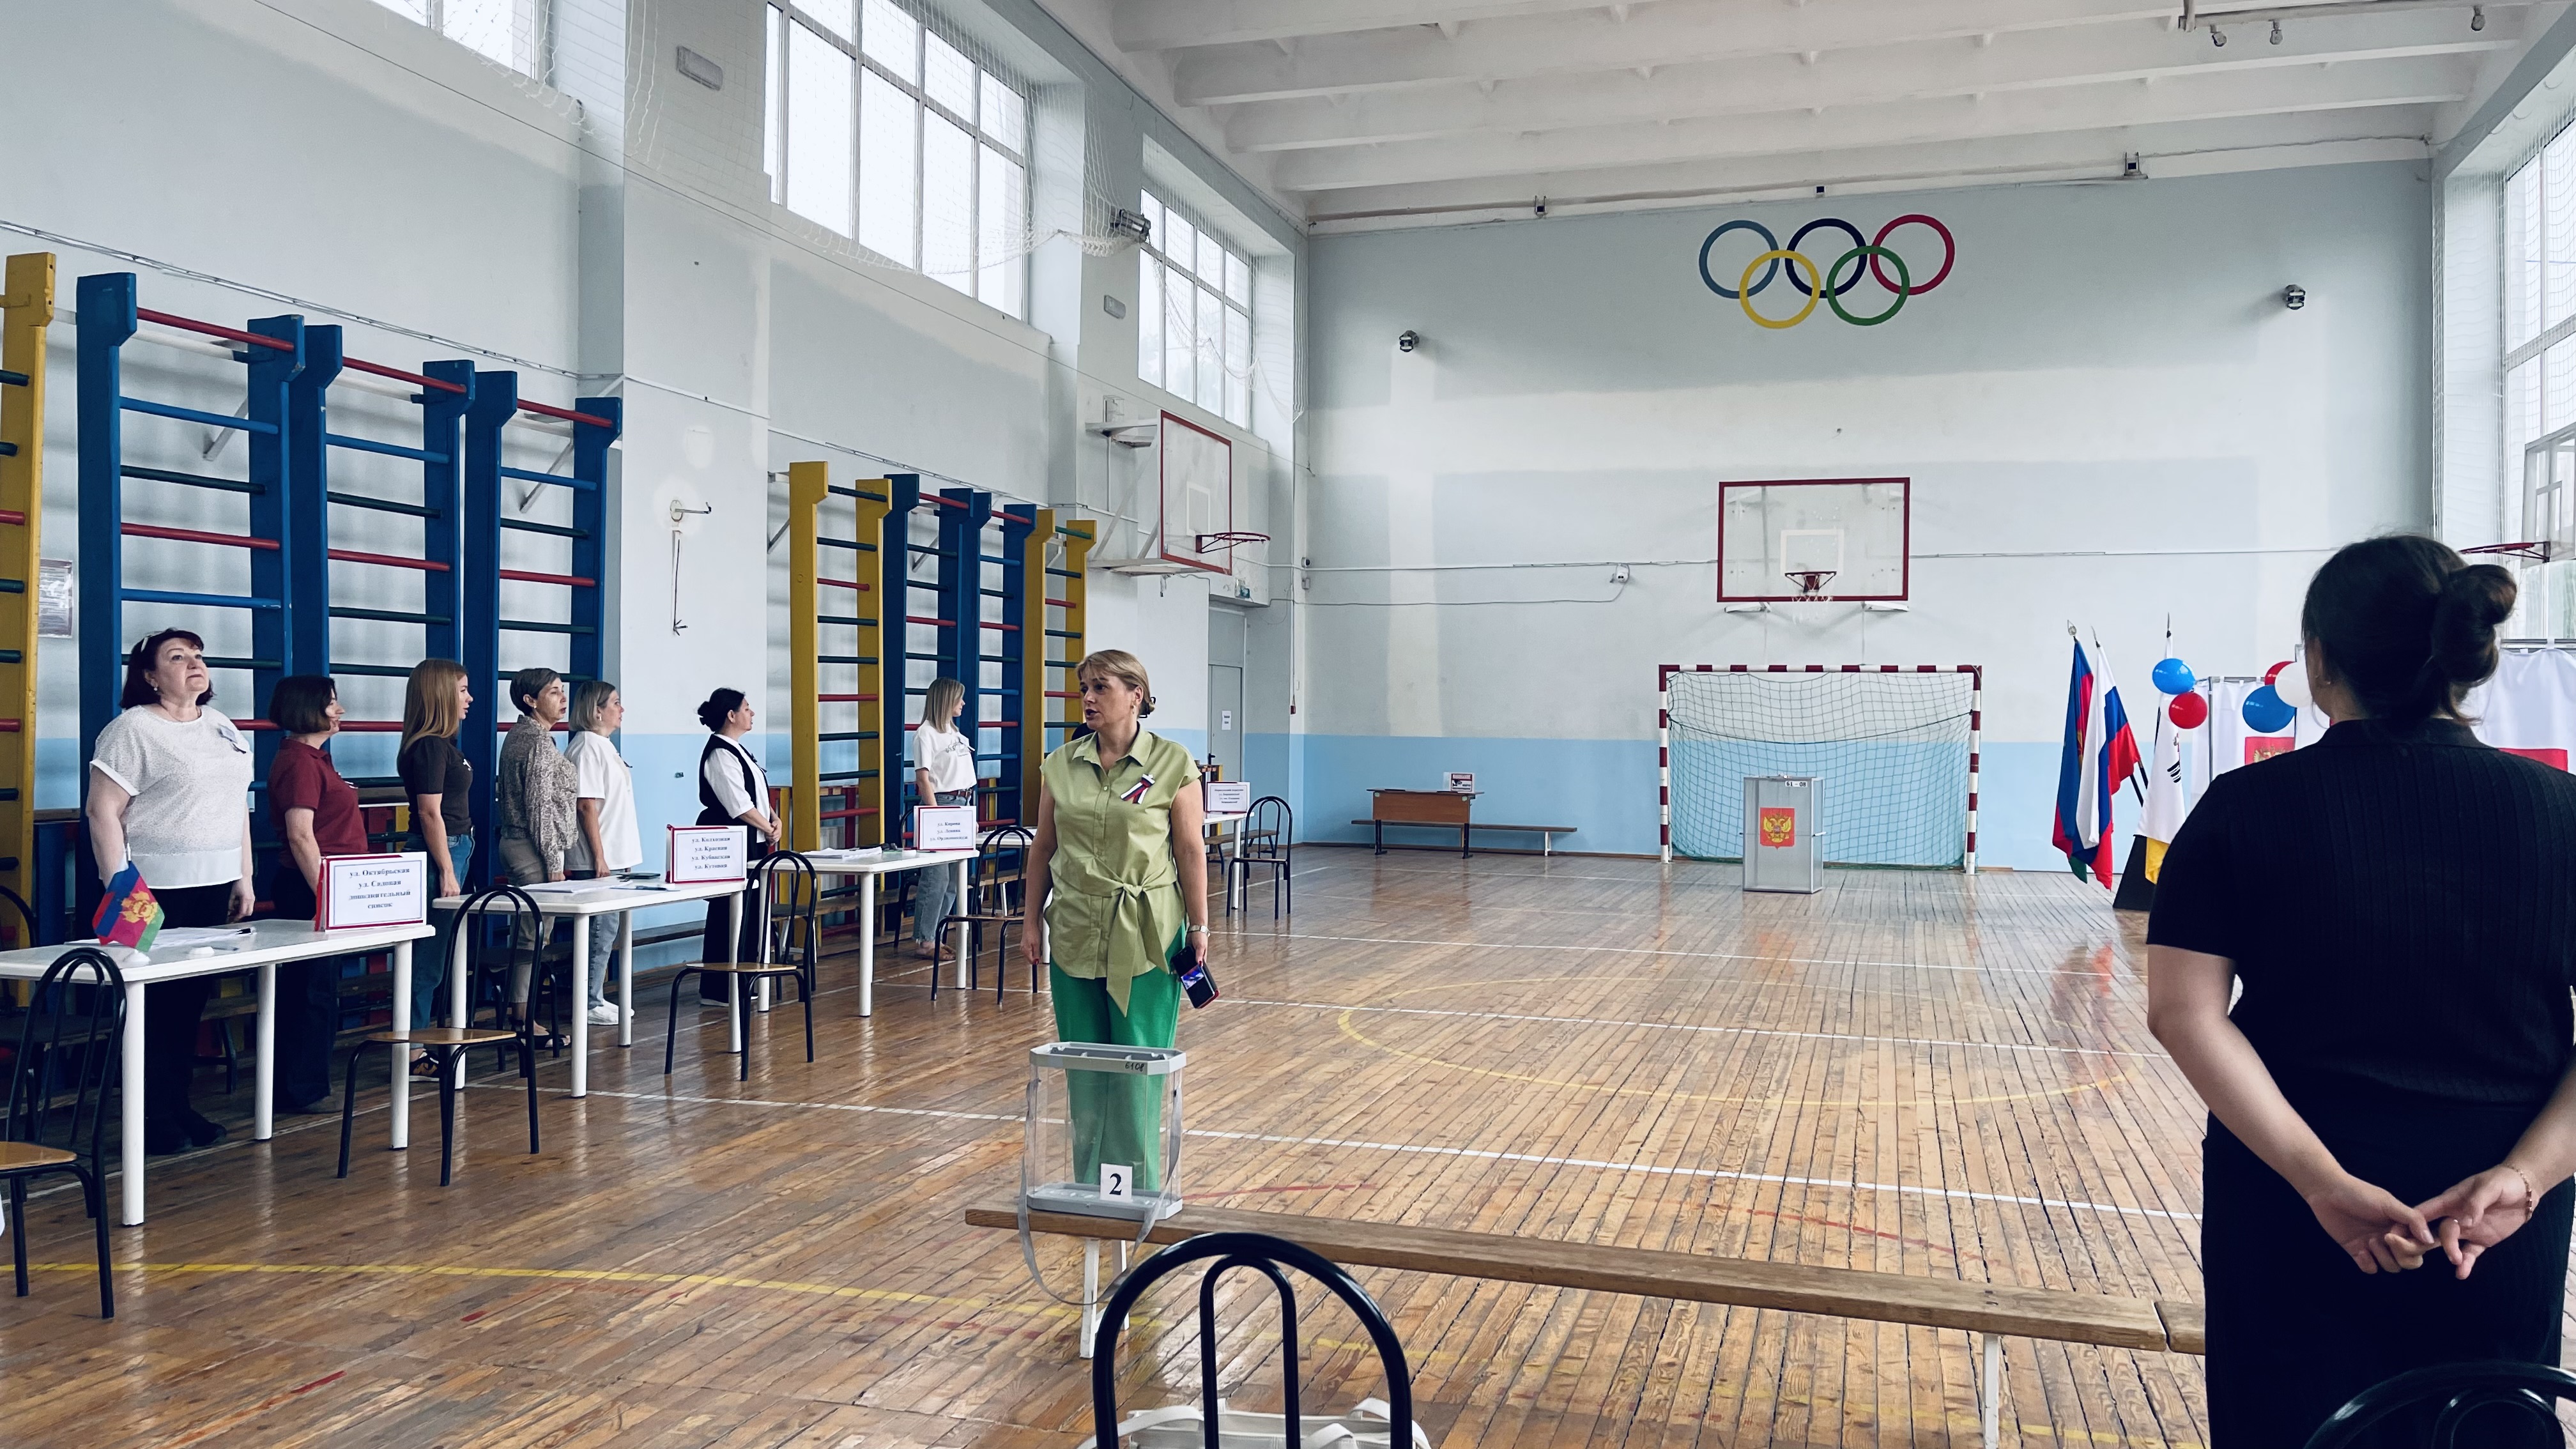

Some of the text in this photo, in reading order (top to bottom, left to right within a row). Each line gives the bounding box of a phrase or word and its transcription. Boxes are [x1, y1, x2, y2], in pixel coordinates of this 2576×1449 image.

[362, 868, 410, 877] Октябрьская
[348, 889, 411, 900] дополнительный
[1108, 1173, 1123, 1196] 2
